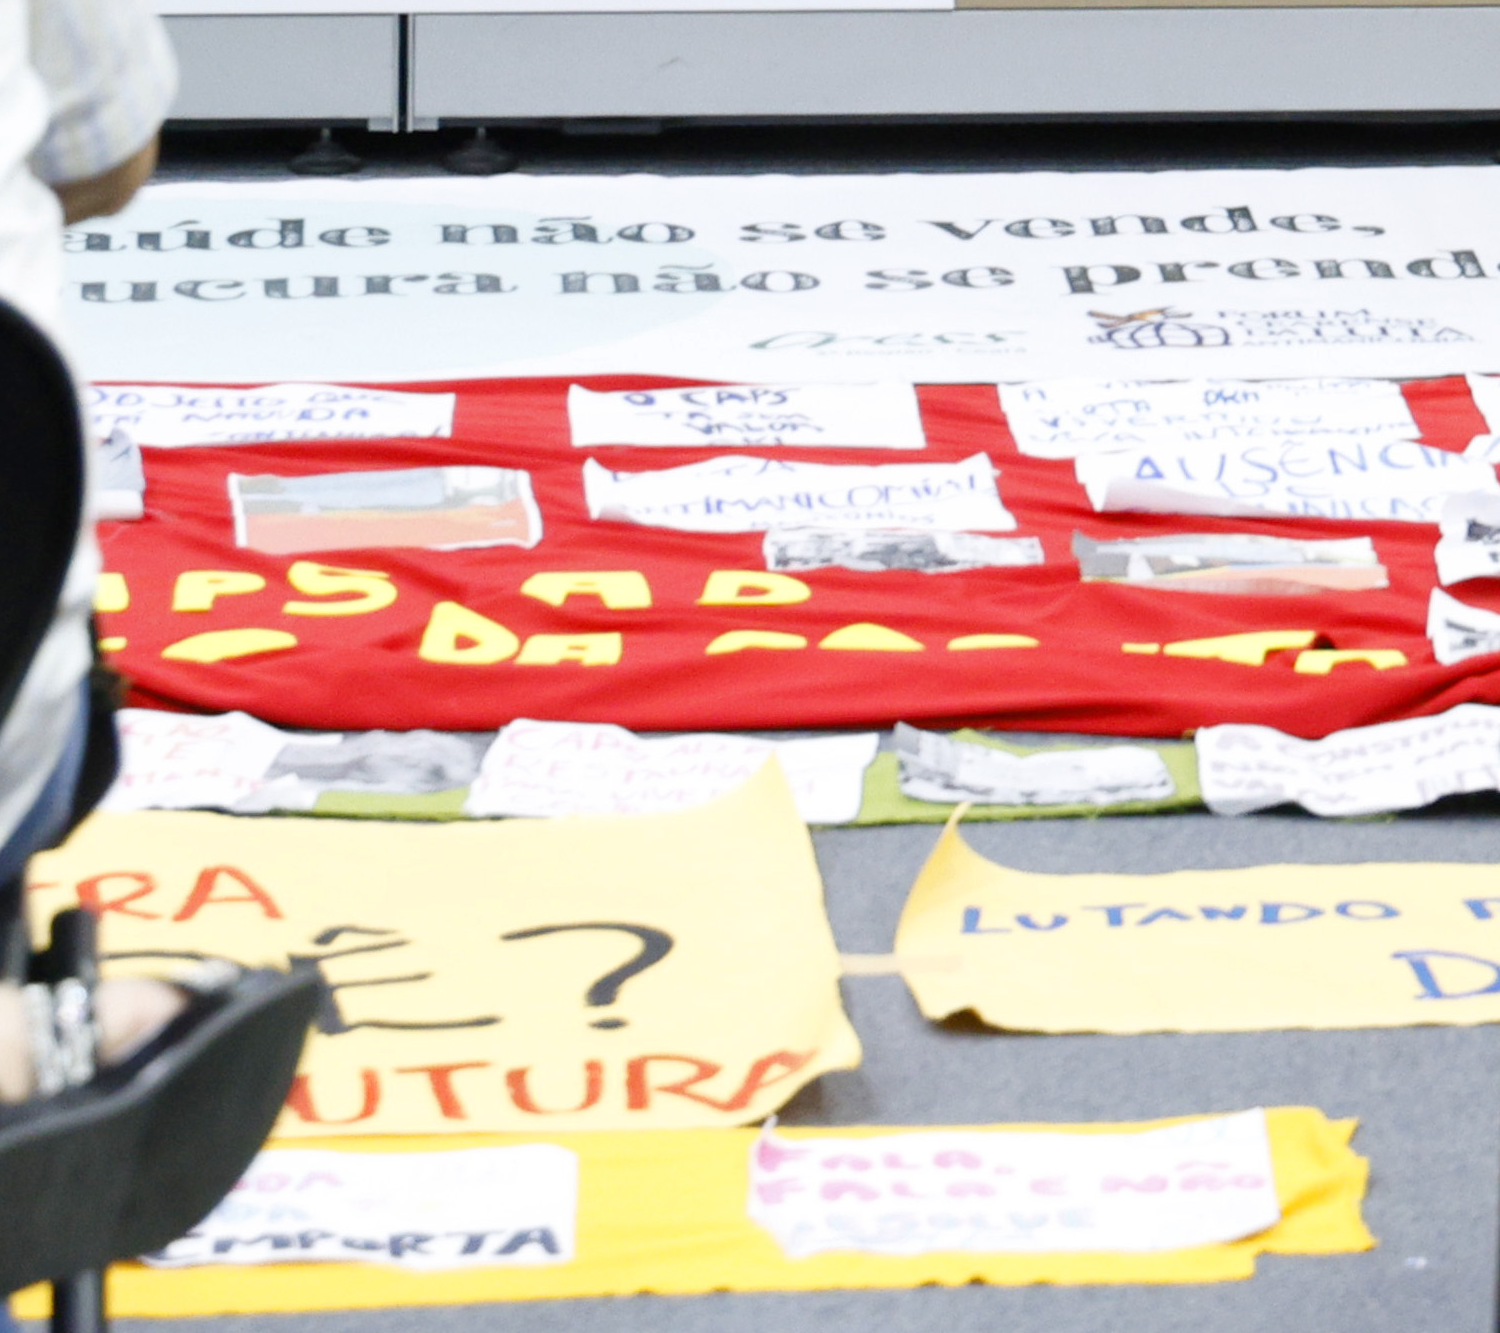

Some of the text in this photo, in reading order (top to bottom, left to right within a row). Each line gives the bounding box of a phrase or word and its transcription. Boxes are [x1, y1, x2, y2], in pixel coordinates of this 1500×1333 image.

[63, 202, 1386, 255] aúde não se vende,
[71, 271, 519, 303] ucura
[551, 262, 821, 297] não
[864, 262, 1017, 290] se
[681, 387, 796, 406] CAPS
[26, 865, 286, 922] RA
[961, 898, 1401, 934] LUTANDO
[287, 1049, 820, 1125] UTURA
